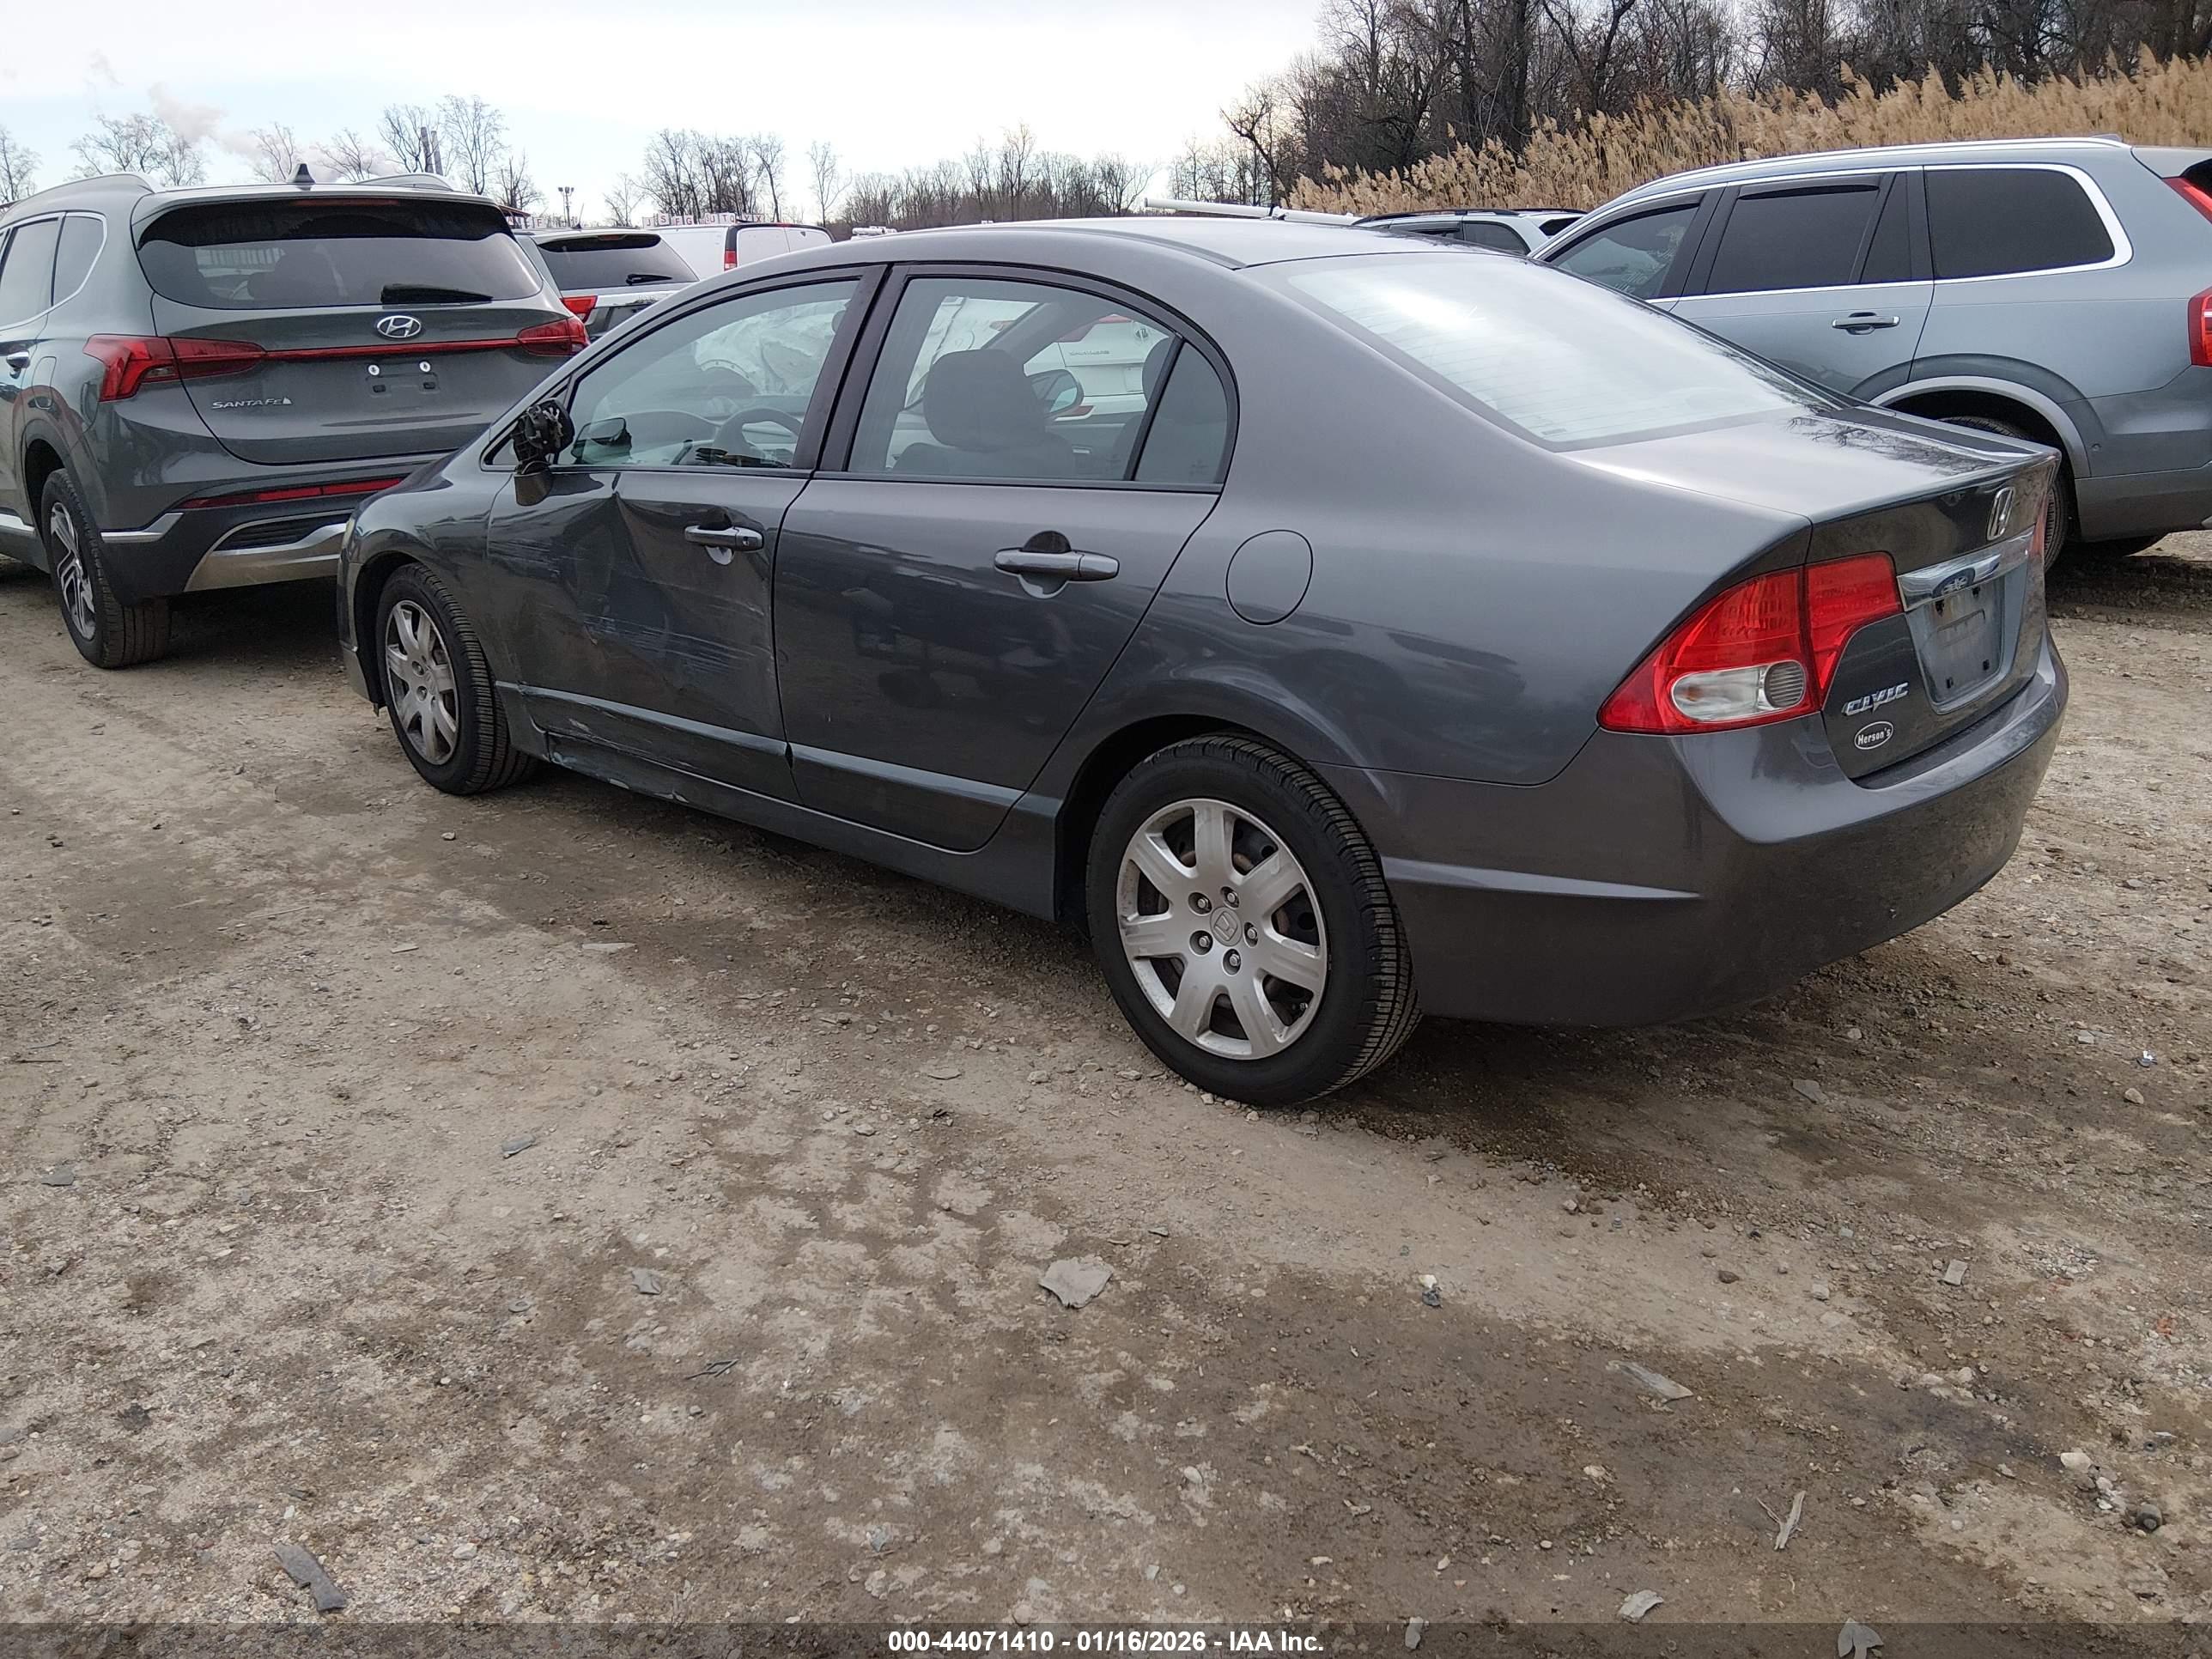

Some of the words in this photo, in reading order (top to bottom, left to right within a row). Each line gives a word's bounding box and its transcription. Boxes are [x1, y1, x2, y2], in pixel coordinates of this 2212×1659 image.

[211, 399, 264, 410] SANTA
[1841, 682, 1909, 716] CIVIC
[1857, 727, 1891, 745] Herson's
